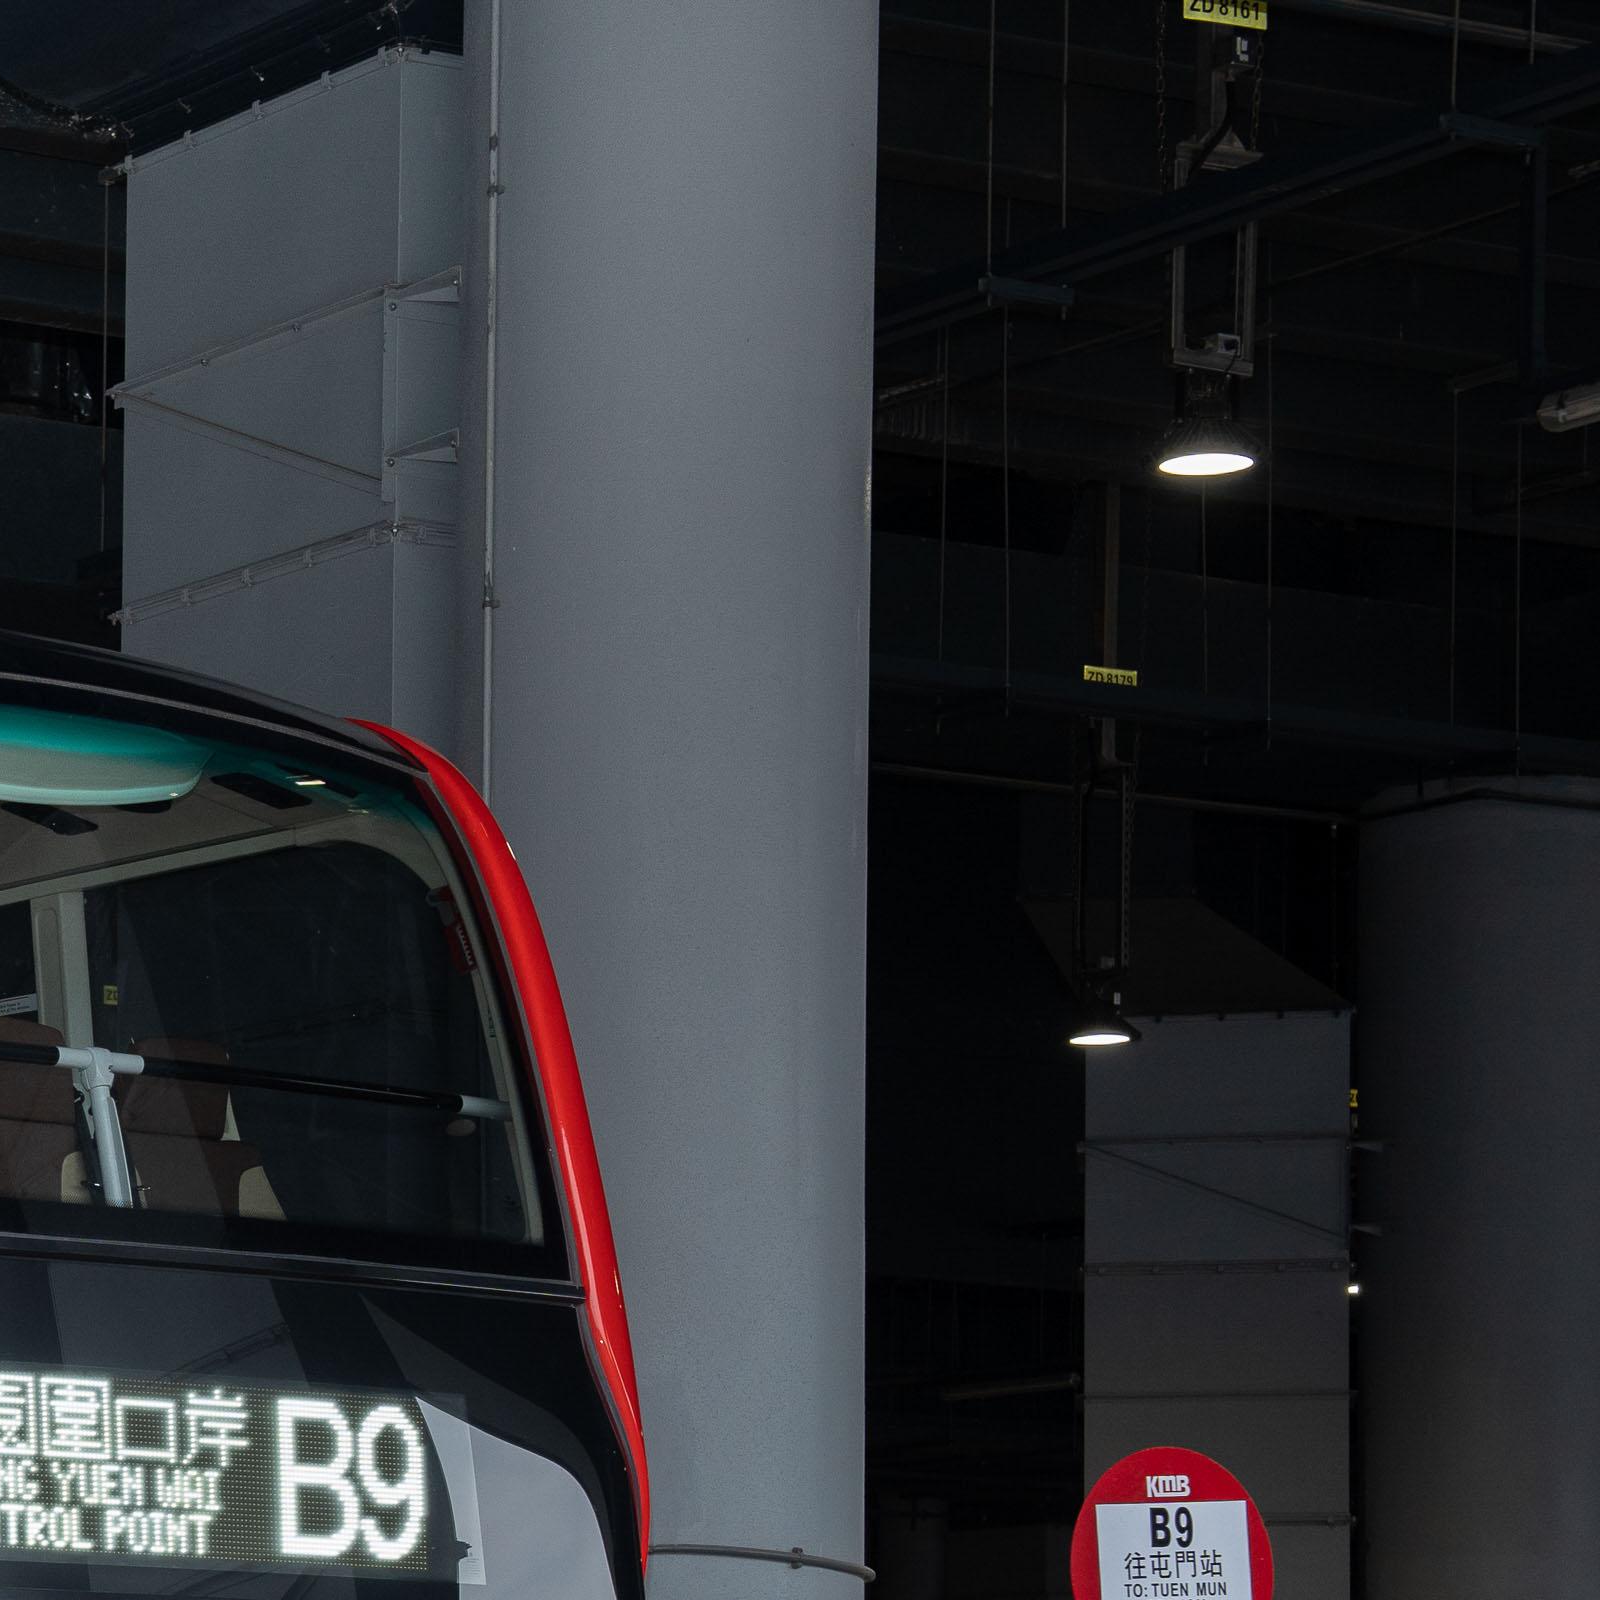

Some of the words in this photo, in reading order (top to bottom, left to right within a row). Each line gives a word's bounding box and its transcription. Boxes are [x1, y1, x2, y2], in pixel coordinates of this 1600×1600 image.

[1189, 0, 1214, 13] ZD
[1219, 1, 1259, 20] 8161
[51, 1461, 145, 1508] YUEN
[156, 1468, 223, 1512] WAI
[275, 1397, 427, 1562] B9
[1145, 1475, 1191, 1498] KMB
[103, 1508, 212, 1556] POINT
[1149, 1506, 1194, 1549] B9
[1124, 1550, 1224, 1581] 往屯門站
[1124, 1584, 1148, 1598] TO:
[1151, 1583, 1189, 1598] TUEN
[1196, 1582, 1227, 1597] MUN
